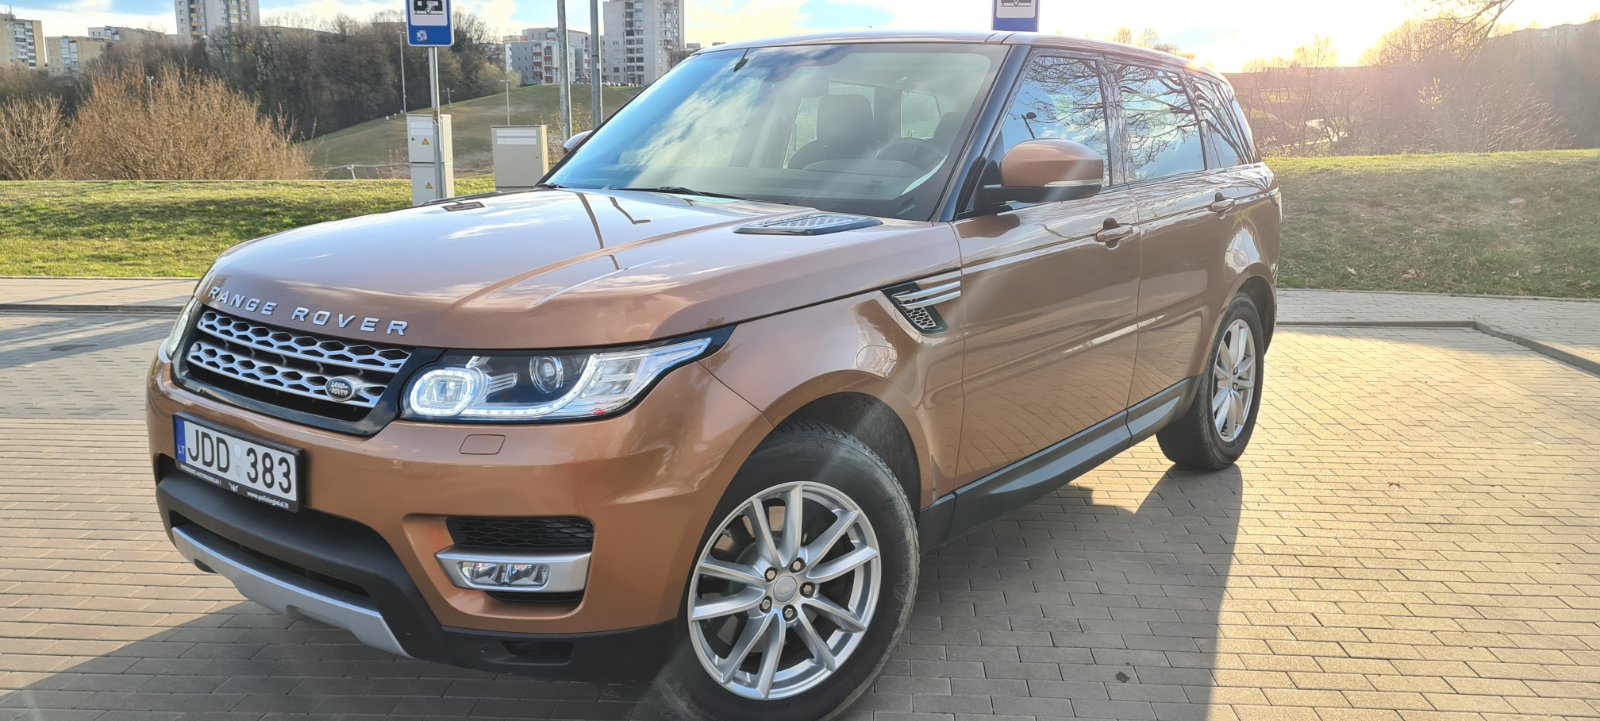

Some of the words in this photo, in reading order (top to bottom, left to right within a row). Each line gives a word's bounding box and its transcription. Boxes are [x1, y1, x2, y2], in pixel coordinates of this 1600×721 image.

[207, 286, 278, 316] RANGE
[291, 306, 409, 336] ROVER
[177, 443, 185, 454] LT
[187, 429, 230, 473] JDD
[246, 447, 292, 494] 383
